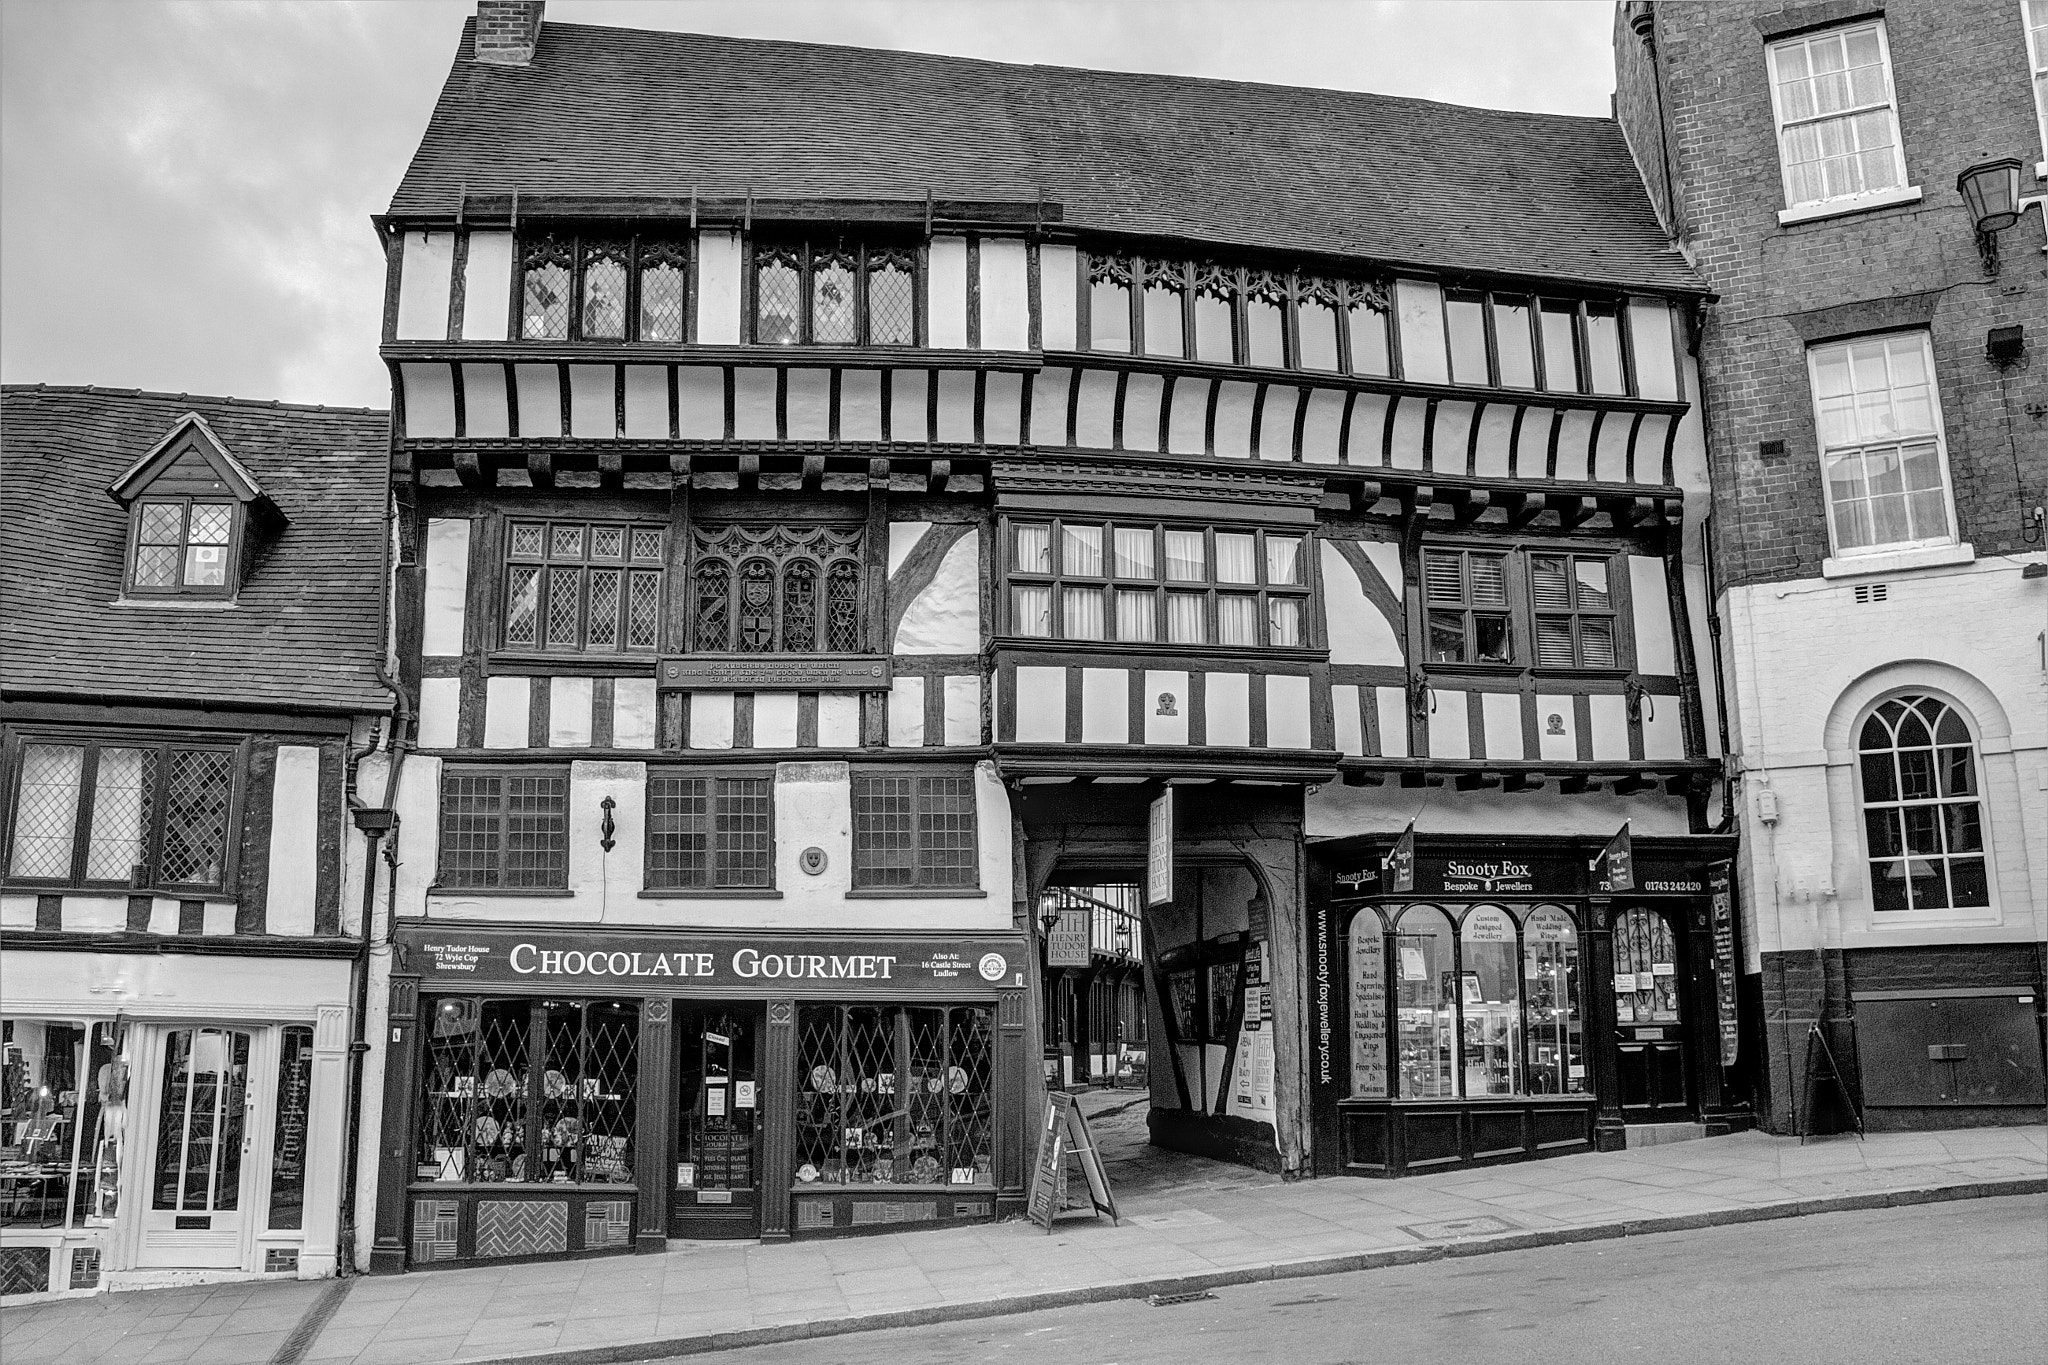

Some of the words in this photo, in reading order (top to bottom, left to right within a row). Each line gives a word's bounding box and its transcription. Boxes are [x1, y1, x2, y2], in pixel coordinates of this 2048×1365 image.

[1448, 861, 1498, 876] Snooty
[1502, 861, 1528, 875] Fox
[1336, 872, 1361, 883] Snooty
[1362, 869, 1376, 880] Fox
[1444, 882, 1478, 892] Bespoke
[1495, 882, 1533, 892] Jewellers
[1645, 882, 1669, 891] 01743
[1670, 882, 1701, 891] 242420
[1475, 914, 1500, 922] Custom
[1530, 914, 1547, 922] Hand
[1549, 914, 1567, 922] Made
[1473, 923, 1503, 932] Designed
[1536, 923, 1562, 932] Wedding
[1051, 934, 1086, 942] HENRY
[1357, 935, 1380, 946] Bespoke
[1472, 931, 1502, 941] Jewellery
[1540, 932, 1558, 941] Rings
[424, 944, 445, 952] Henry
[447, 945, 466, 953] Tudor
[468, 945, 490, 953] House
[1051, 942, 1086, 950] TUDOR
[1355, 946, 1381, 955] Jewellery
[435, 953, 444, 961] 72
[445, 953, 462, 962] Wyle
[463, 954, 478, 963] Cop
[1051, 950, 1086, 958] HOUSE
[509, 943, 716, 976] CHOCOLATE
[732, 948, 897, 979] GOURMET
[952, 961, 971, 969] Street
[436, 962, 476, 971] Shrewsbury
[933, 969, 959, 977] Ludlow
[1362, 971, 1378, 979] Hand
[1356, 981, 1384, 992] Engraving
[1317, 910, 1332, 1084] www.snootyfoxjewellery.co.uk
[1354, 1010, 1370, 1019] Hand
[1355, 1020, 1379, 1030] Wedding
[1363, 1041, 1379, 1051] Rings
[1355, 1063, 1370, 1071] From
[1371, 1062, 1387, 1071] Silve
[1467, 1059, 1491, 1069] Hand
[1493, 1058, 1518, 1069] Mae
[1369, 1073, 1376, 1082] To
[1360, 1084, 1385, 1093] Platinum
